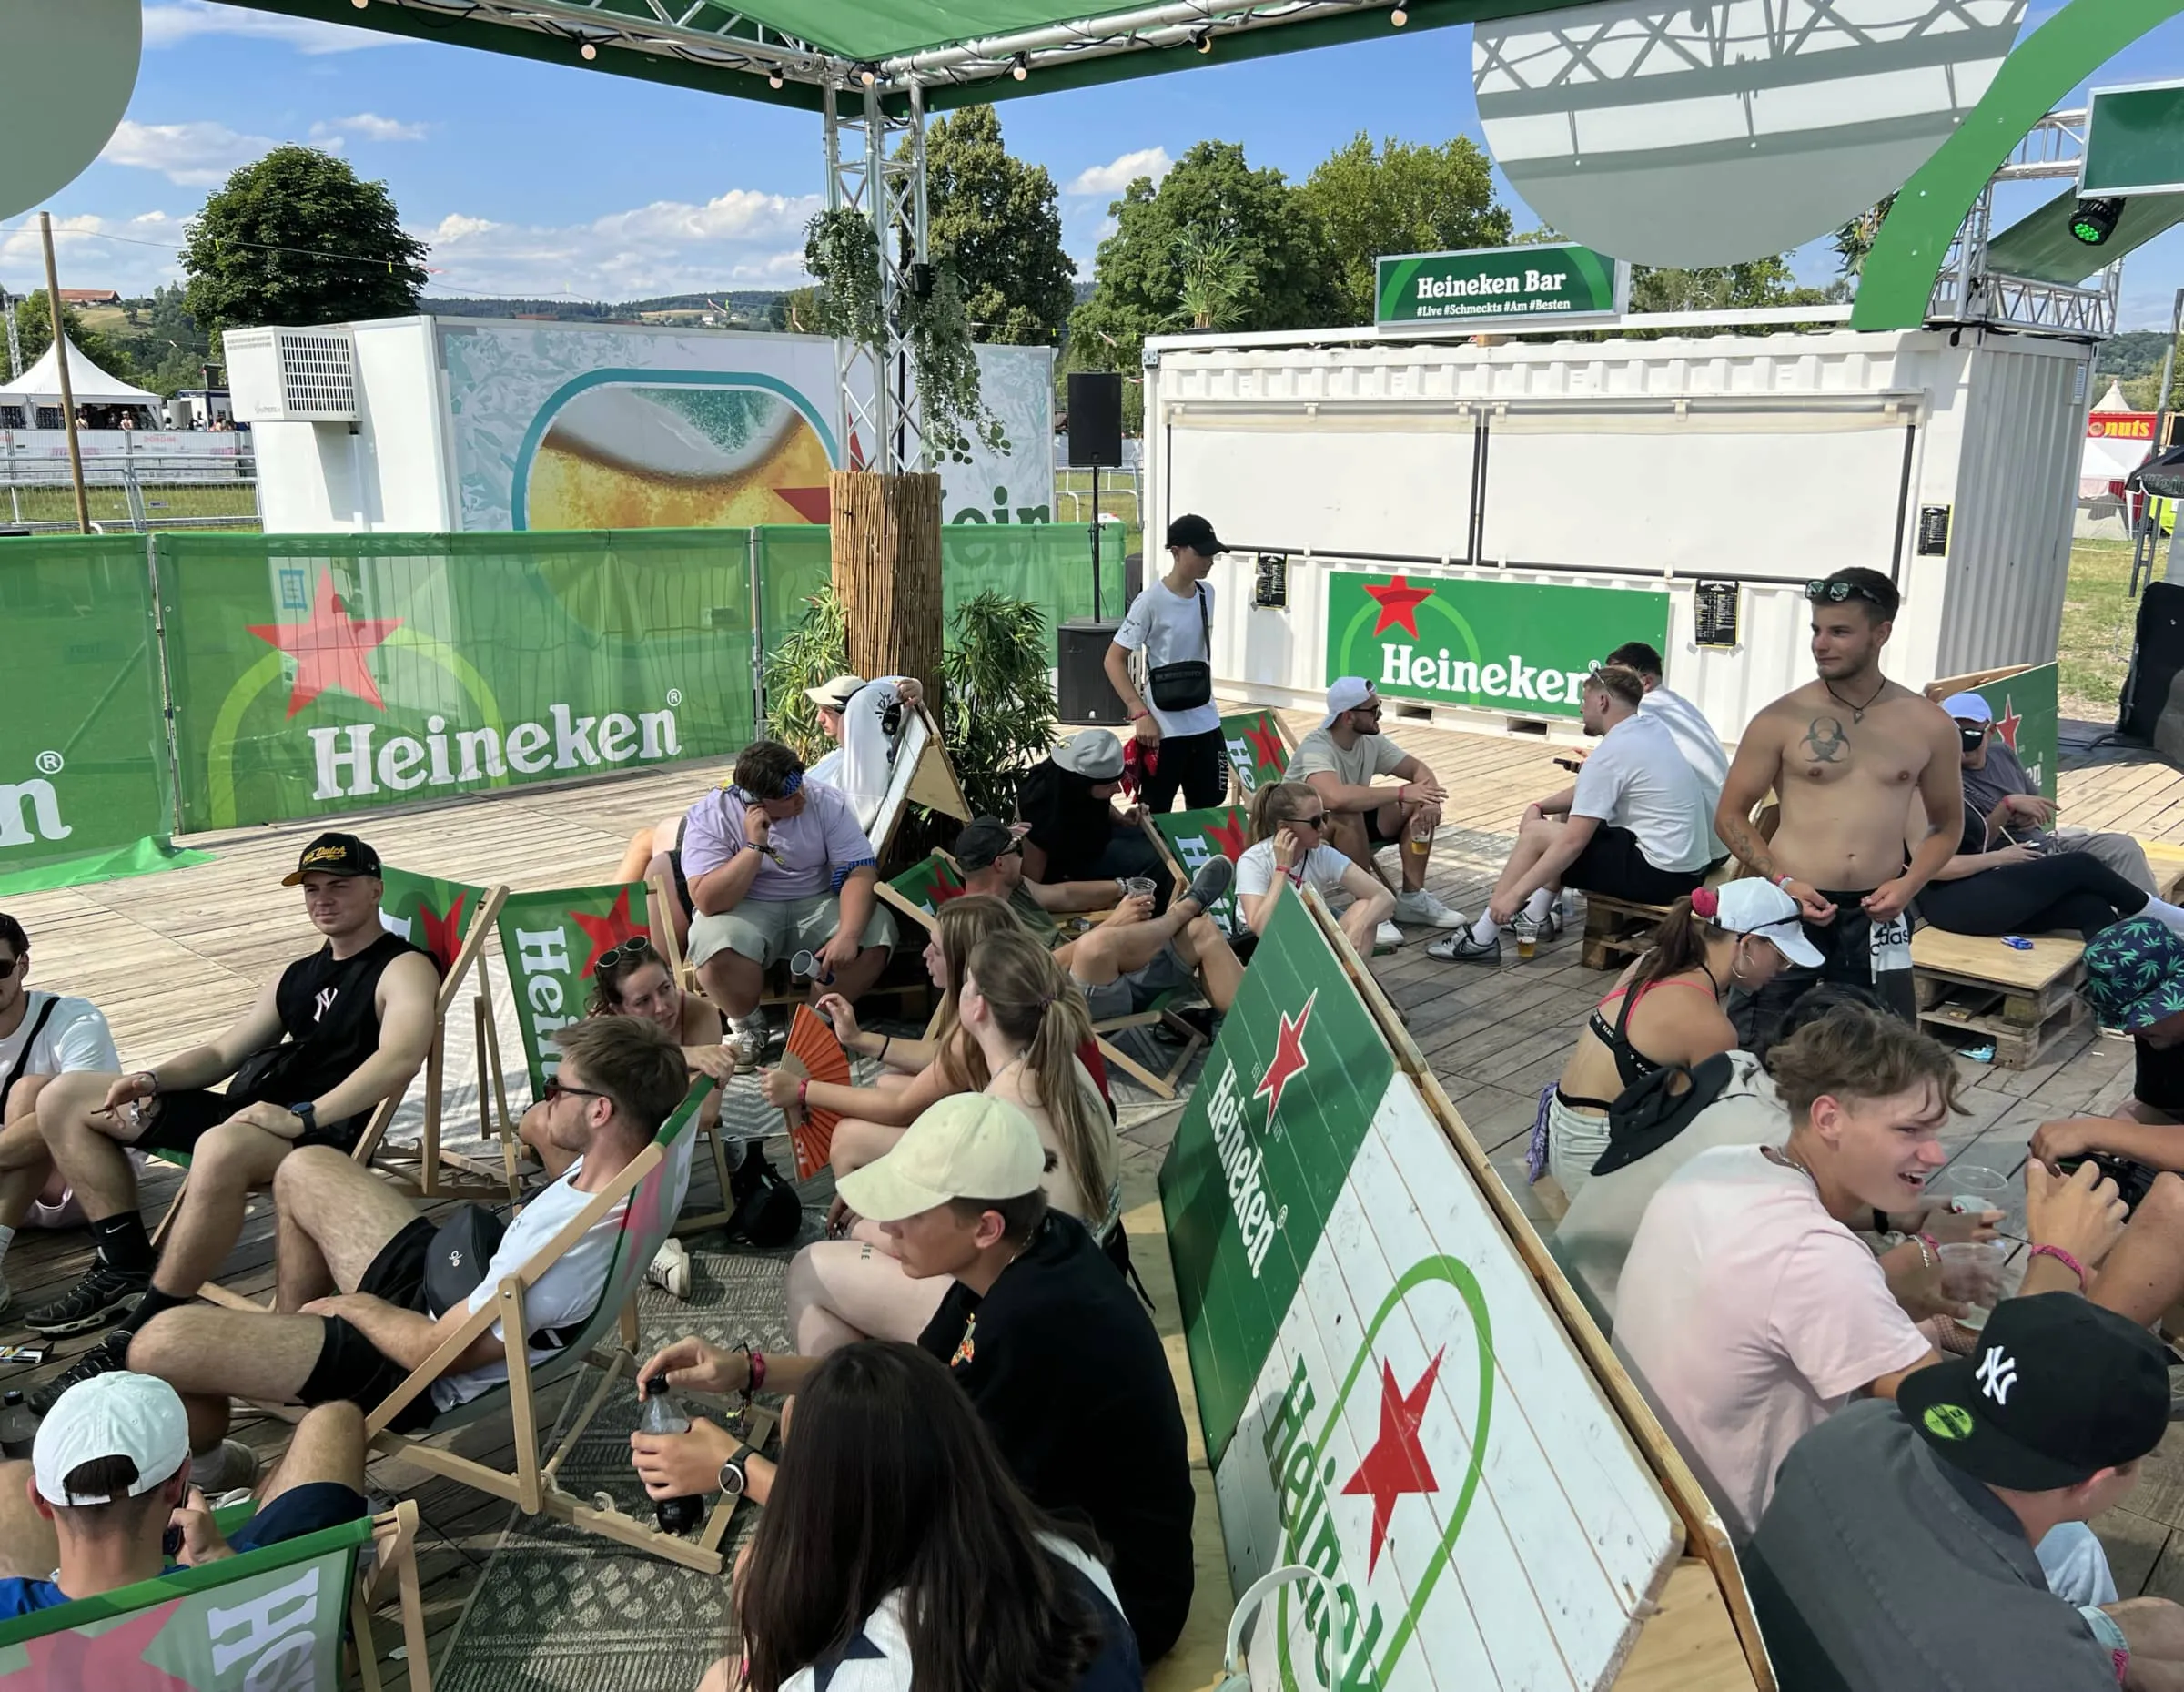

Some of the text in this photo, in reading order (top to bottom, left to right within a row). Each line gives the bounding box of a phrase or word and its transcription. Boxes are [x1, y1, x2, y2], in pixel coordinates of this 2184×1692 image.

[1416, 269, 1567, 299] Heineken Bar
[1416, 299, 1571, 317] #Live #Schmeckts #Am #Besten
